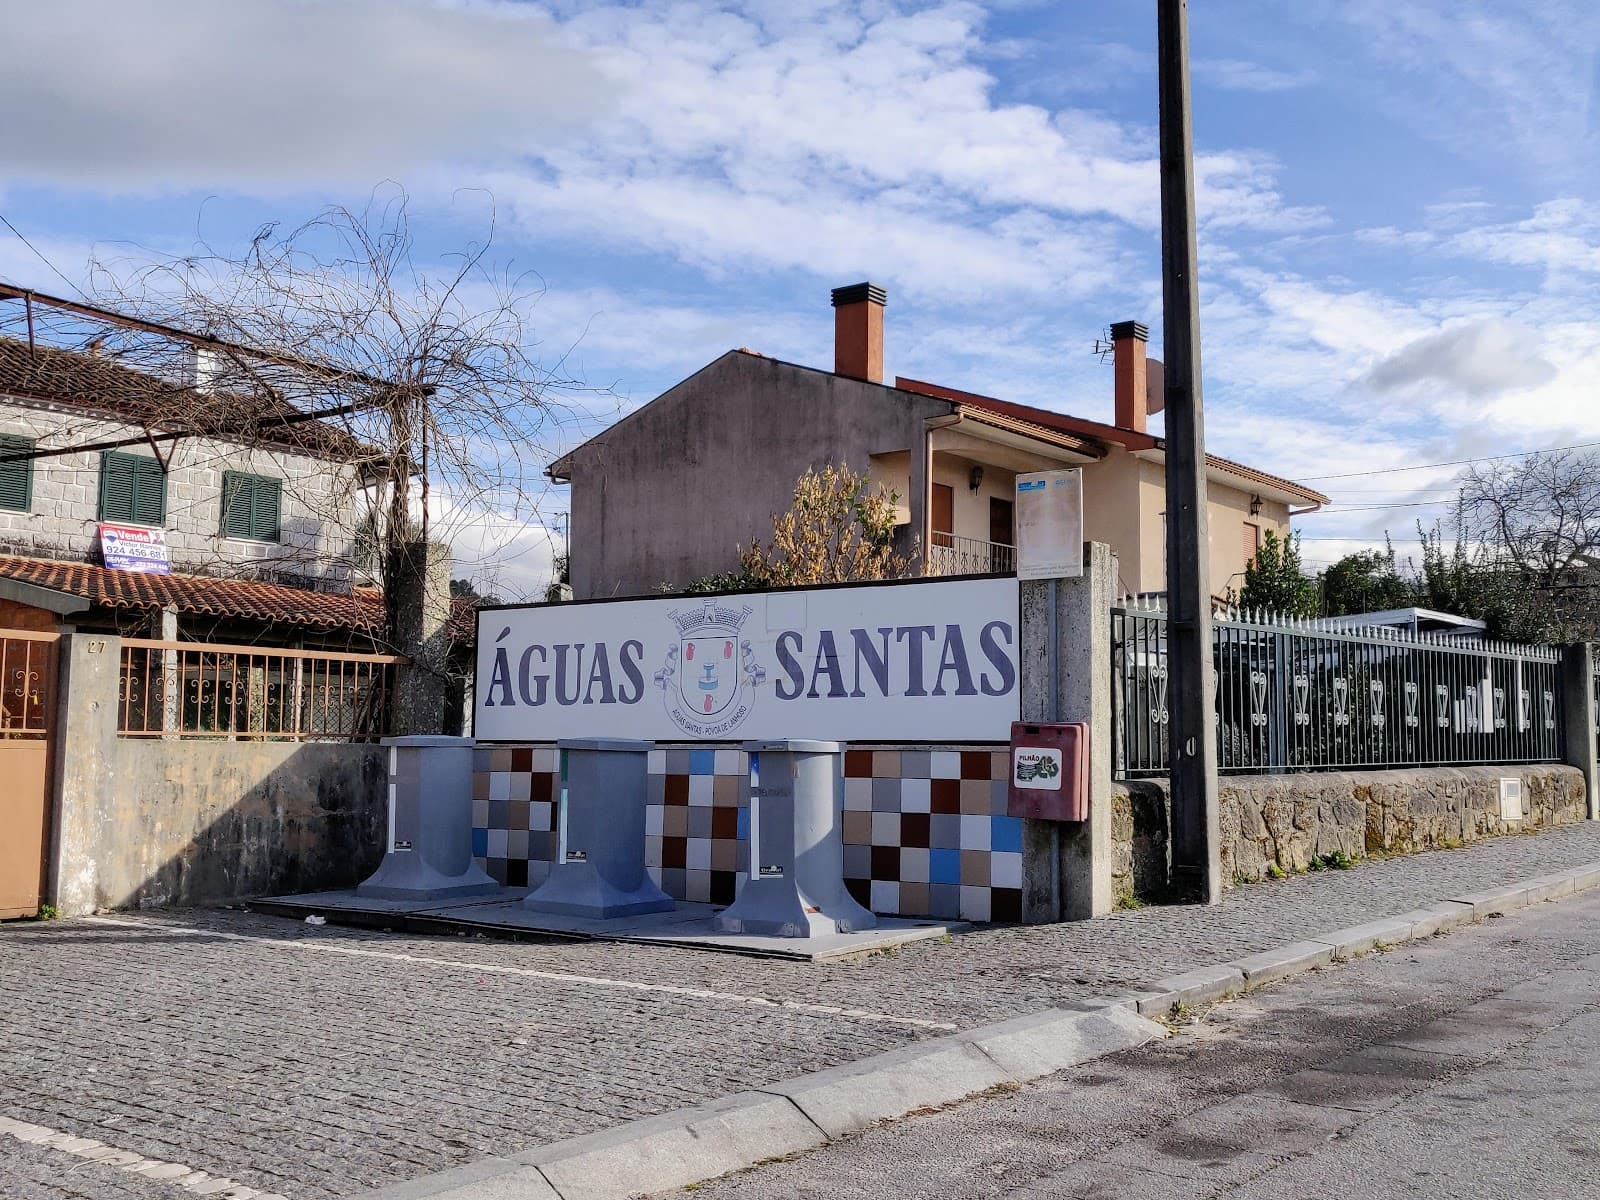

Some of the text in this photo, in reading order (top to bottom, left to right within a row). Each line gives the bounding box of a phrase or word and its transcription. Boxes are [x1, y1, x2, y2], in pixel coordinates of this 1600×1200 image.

[117, 530, 150, 543] Vende
[106, 545, 126, 554] 924
[128, 548, 147, 557] 456
[88, 640, 107, 654] 27
[485, 620, 1016, 706] ÁGUAS SANTAS
